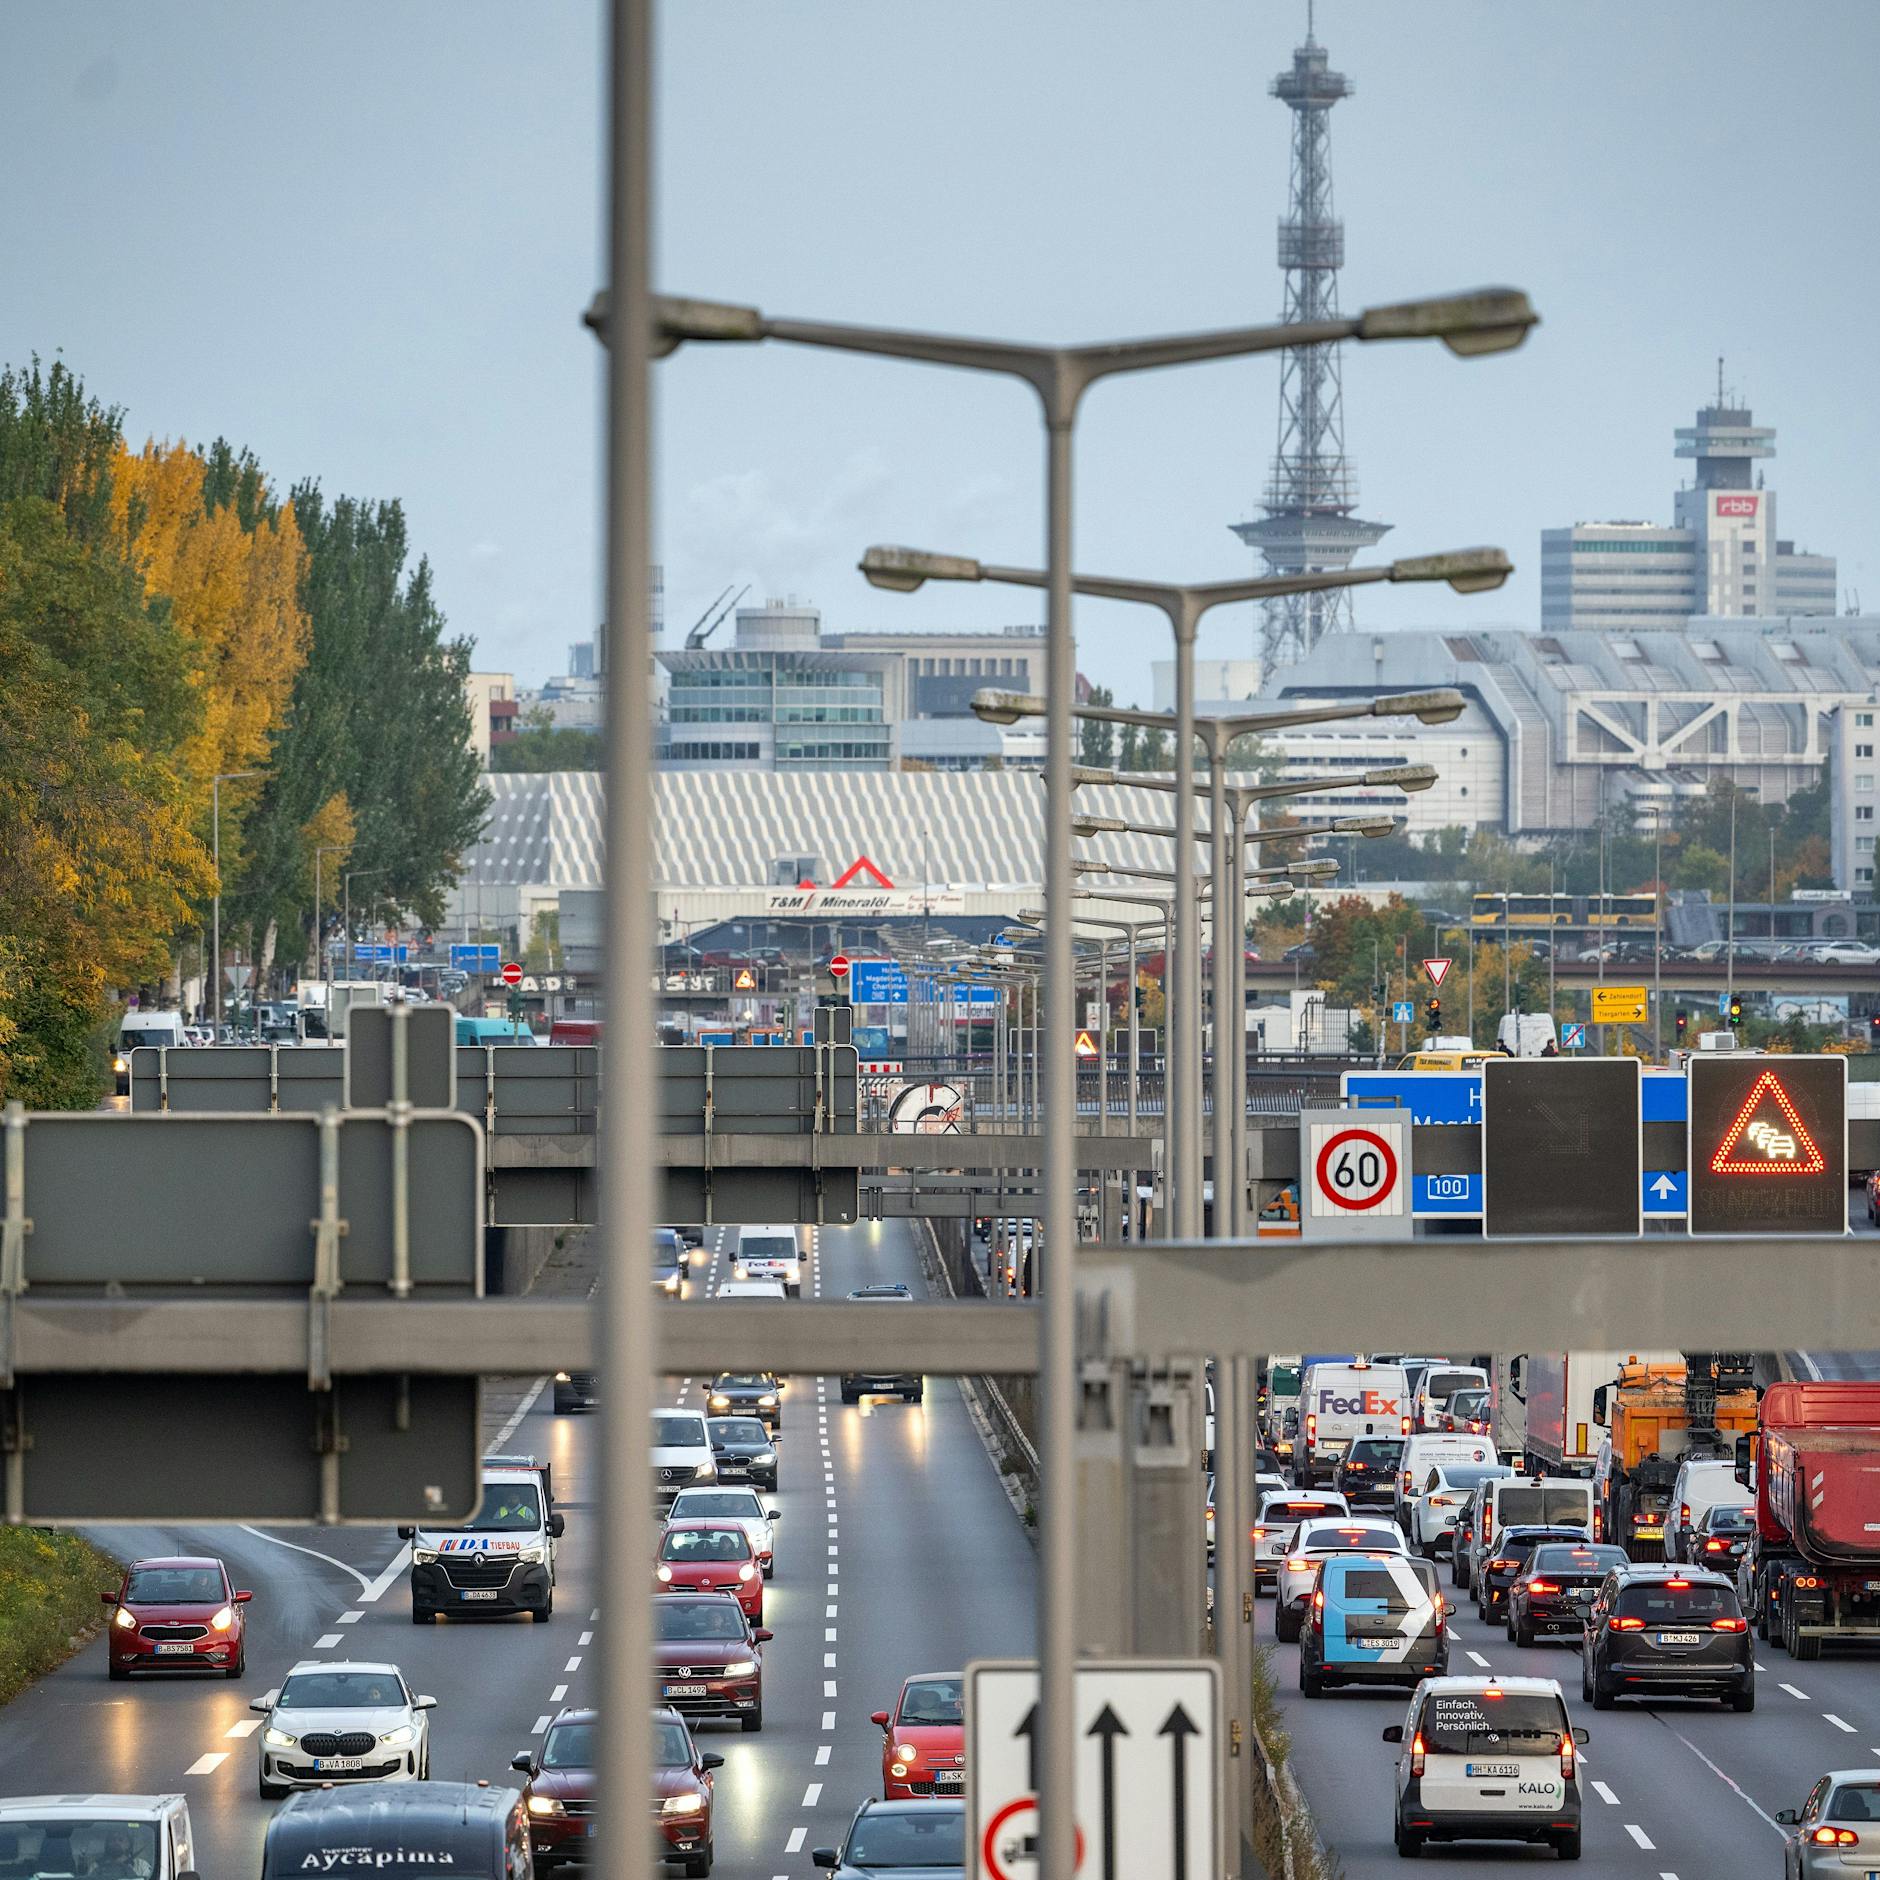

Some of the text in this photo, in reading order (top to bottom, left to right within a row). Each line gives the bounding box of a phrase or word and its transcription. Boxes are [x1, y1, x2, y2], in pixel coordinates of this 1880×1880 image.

[1721, 500, 1753, 513] rbb
[770, 897, 803, 908] T&M
[820, 896, 890, 908] Mineralöl
[1335, 1152, 1380, 1188] 60
[1435, 1180, 1462, 1195] 100
[1320, 1390, 1398, 1415] FedEx
[490, 1541, 520, 1551] TIEFBAU
[1436, 1700, 1478, 1710] Einfach.
[1436, 1711, 1486, 1720] Innovativ.
[1436, 1721, 1493, 1731] Persönlich.
[1518, 1782, 1555, 1794] KALO
[301, 1848, 455, 1871] Aycapima
